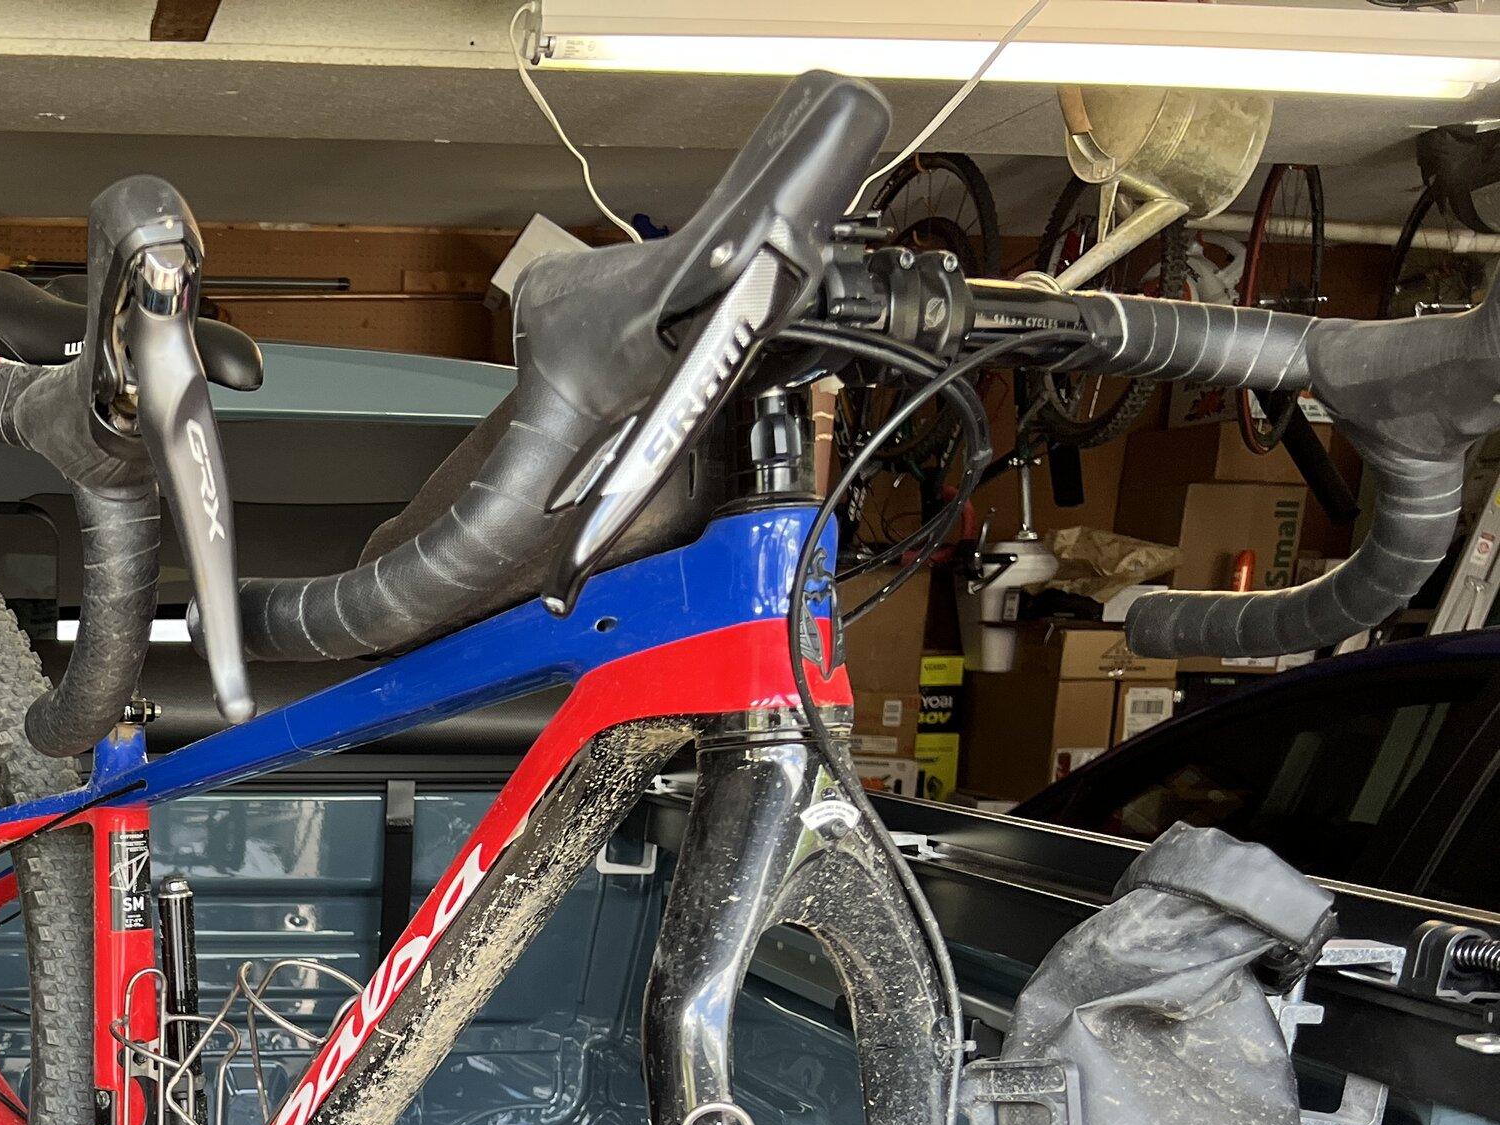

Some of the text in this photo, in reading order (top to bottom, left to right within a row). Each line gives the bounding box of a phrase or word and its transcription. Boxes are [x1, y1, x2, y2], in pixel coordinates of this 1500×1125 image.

[186, 418, 226, 543] GRX
[1265, 500, 1300, 588] Small
[122, 896, 145, 912] SM
